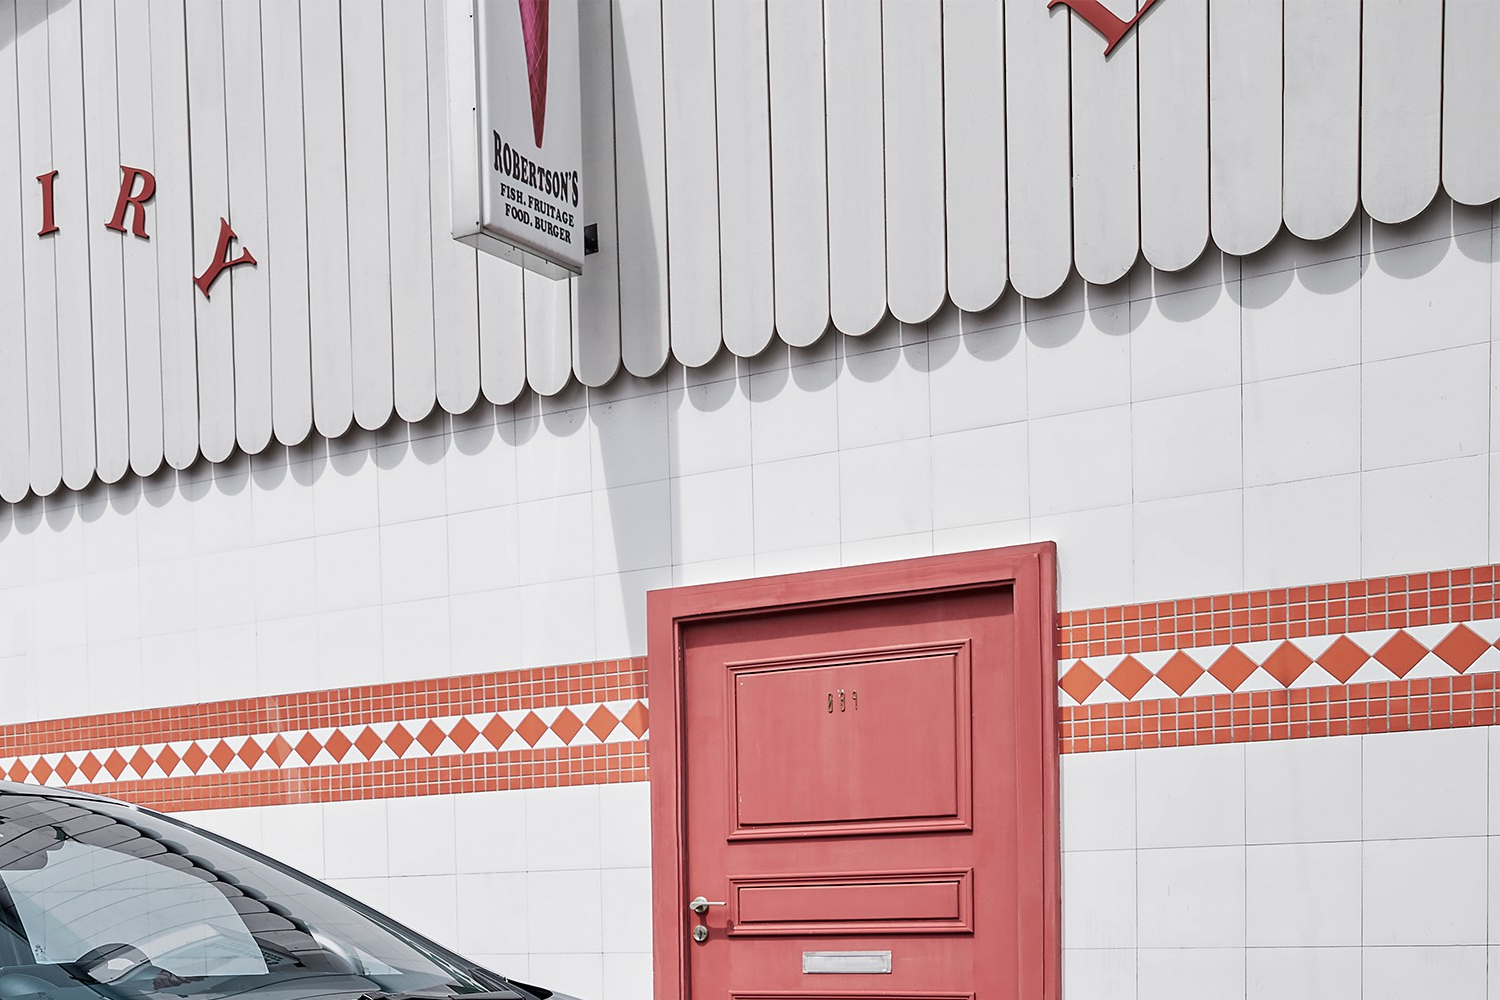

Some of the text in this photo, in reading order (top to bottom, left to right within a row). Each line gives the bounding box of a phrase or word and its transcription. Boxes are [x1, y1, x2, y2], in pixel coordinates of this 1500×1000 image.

[493, 129, 578, 208] ROBERTSON'S
[500, 182, 575, 228] FISH. FRUITAGE
[505, 203, 572, 244] FOOD. BURGER
